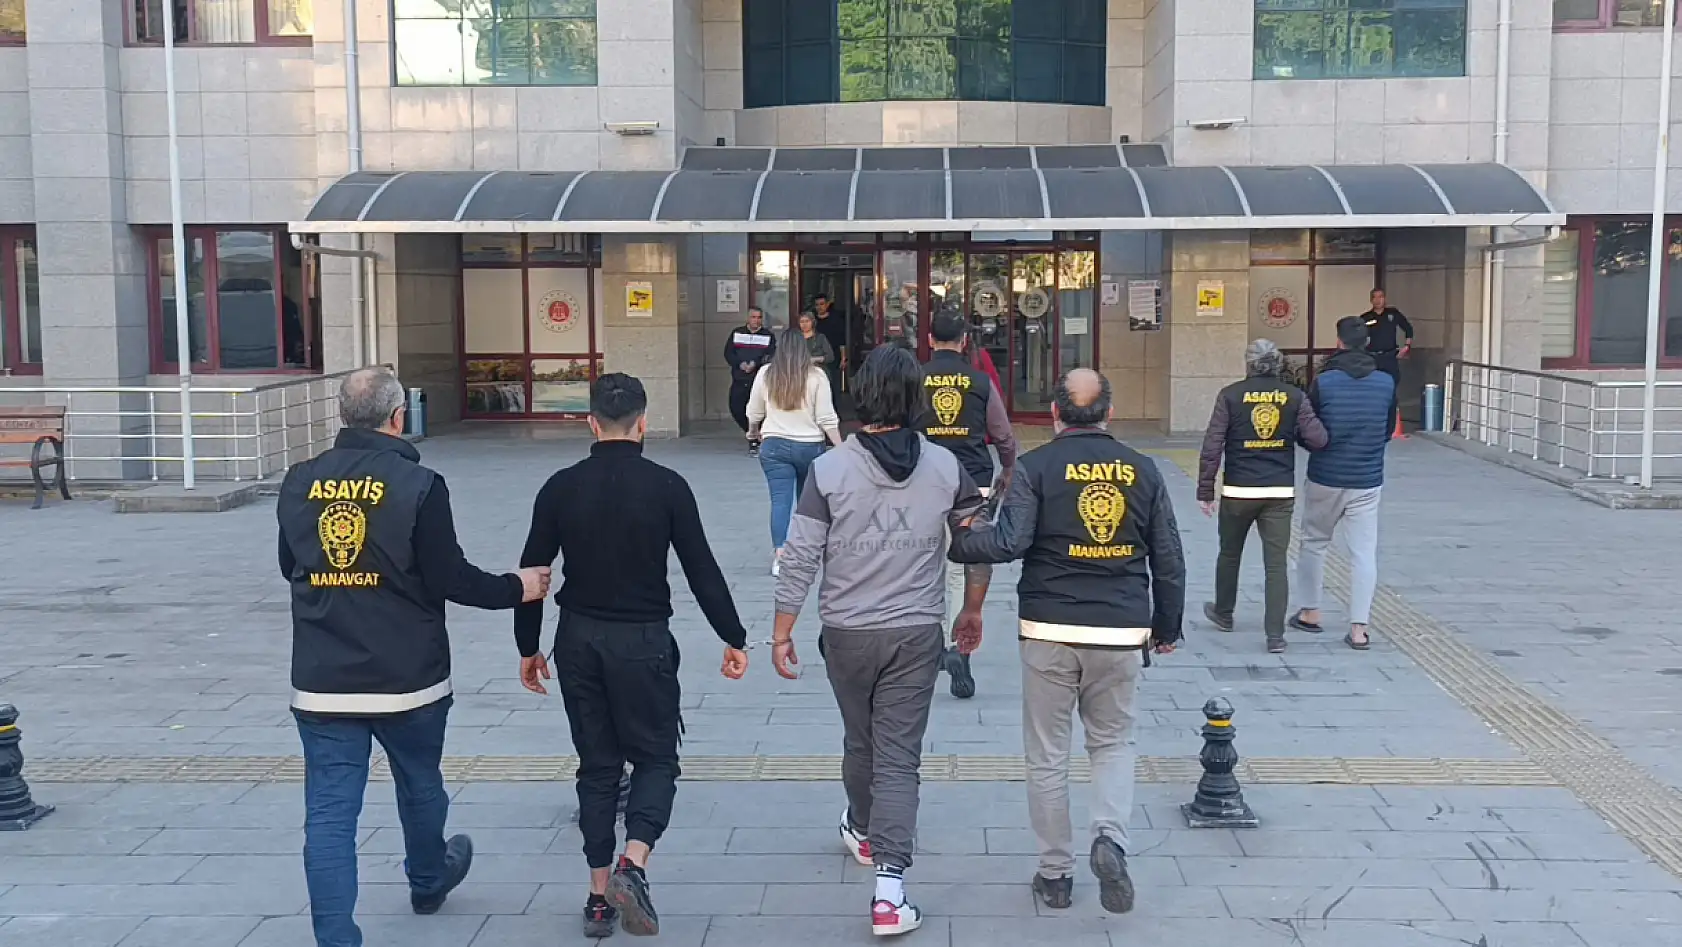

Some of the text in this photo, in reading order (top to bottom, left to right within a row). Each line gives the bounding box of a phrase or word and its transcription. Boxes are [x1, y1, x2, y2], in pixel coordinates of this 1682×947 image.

[924, 373, 971, 389] ASAYİŞ
[1243, 389, 1288, 405] ASAYİŞ
[1065, 459, 1135, 486] ASAYİŞ
[308, 475, 384, 505] ASAYİŞ
[1068, 543, 1135, 558] MANAVGAT
[310, 572, 380, 586] MANAVGAT
